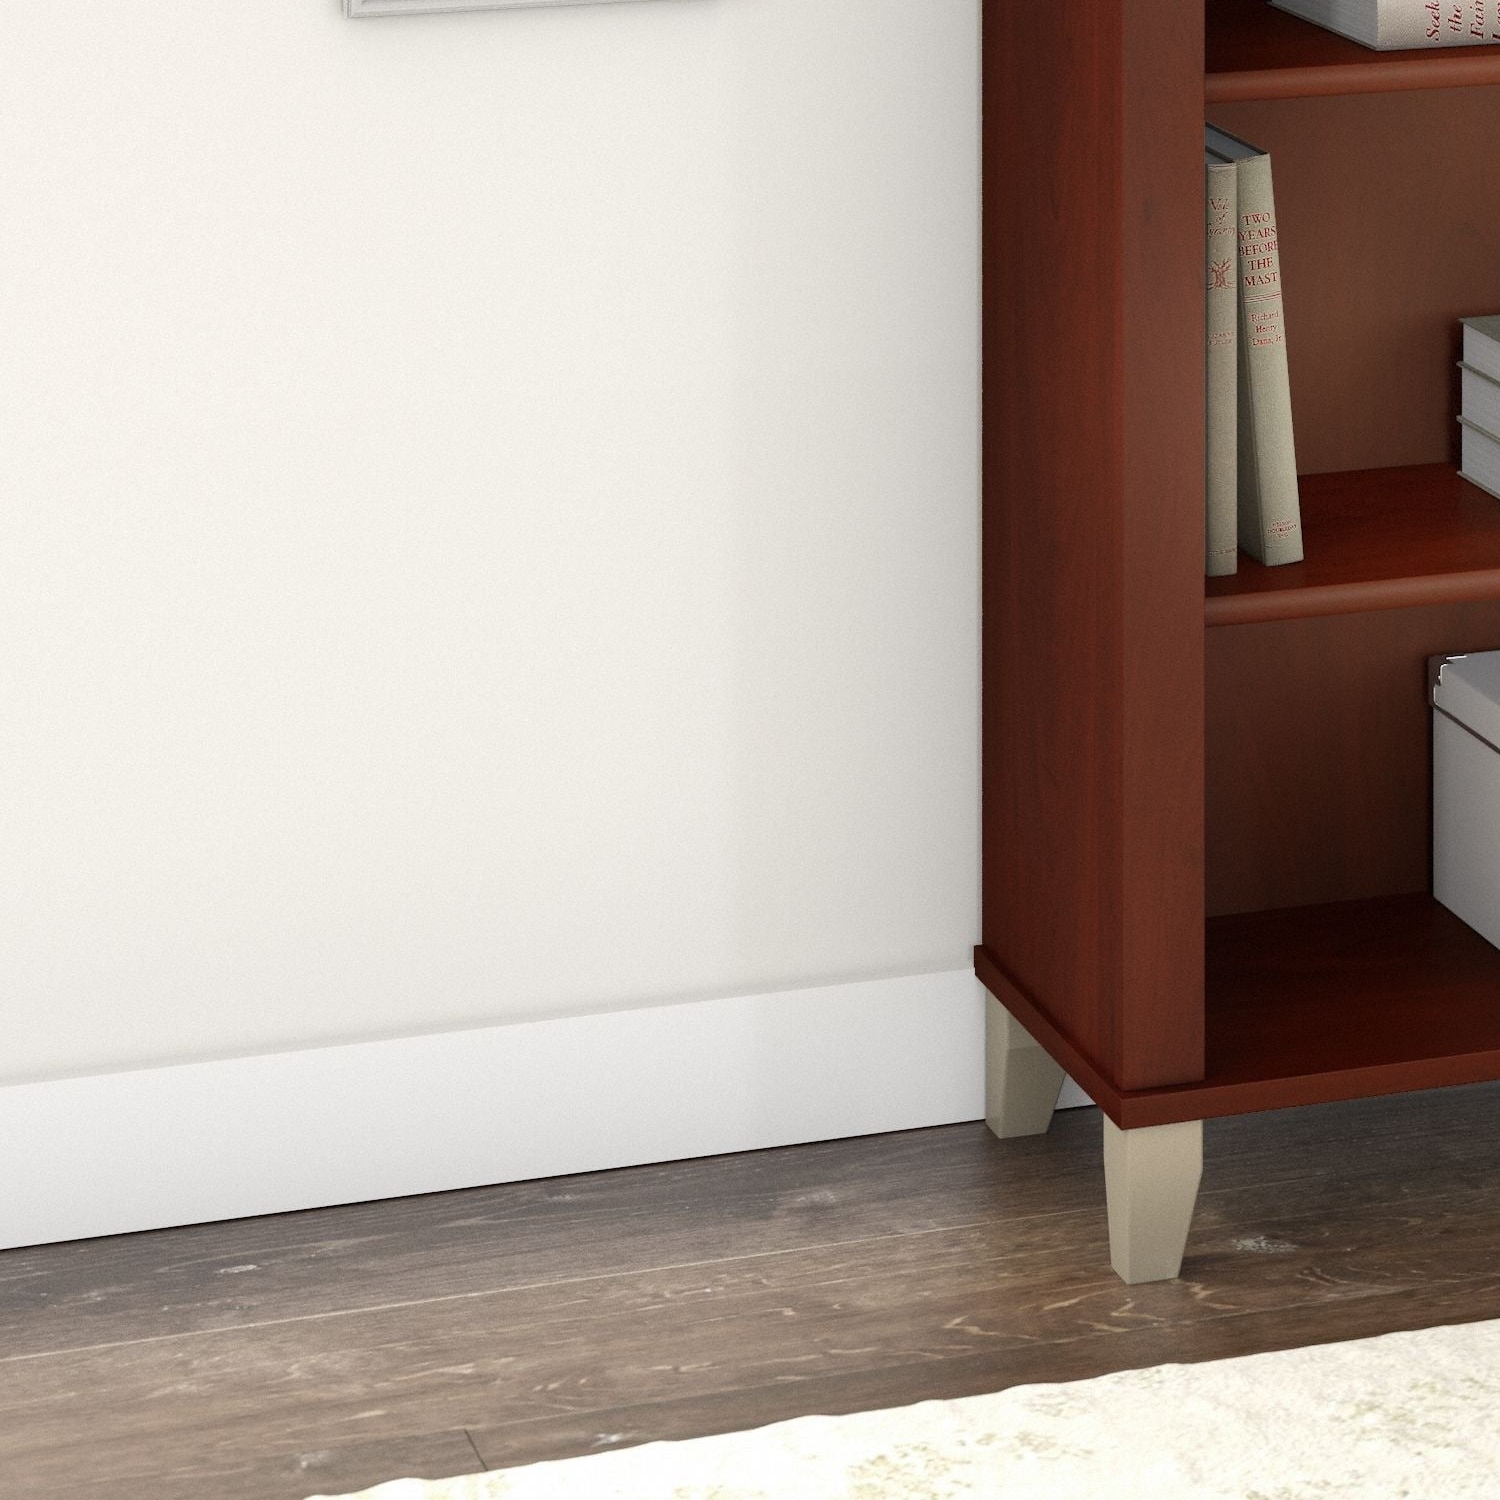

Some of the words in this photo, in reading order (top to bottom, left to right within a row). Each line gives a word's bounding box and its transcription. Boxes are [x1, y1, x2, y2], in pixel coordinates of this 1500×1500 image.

[1425, 0, 1440, 41] Seek
[1448, 4, 1463, 33] the
[1242, 212, 1271, 226] TWO
[1238, 226, 1276, 241] YEARS
[1247, 256, 1273, 271] THE
[1244, 272, 1278, 287] MAST
[1251, 310, 1279, 322] Richard
